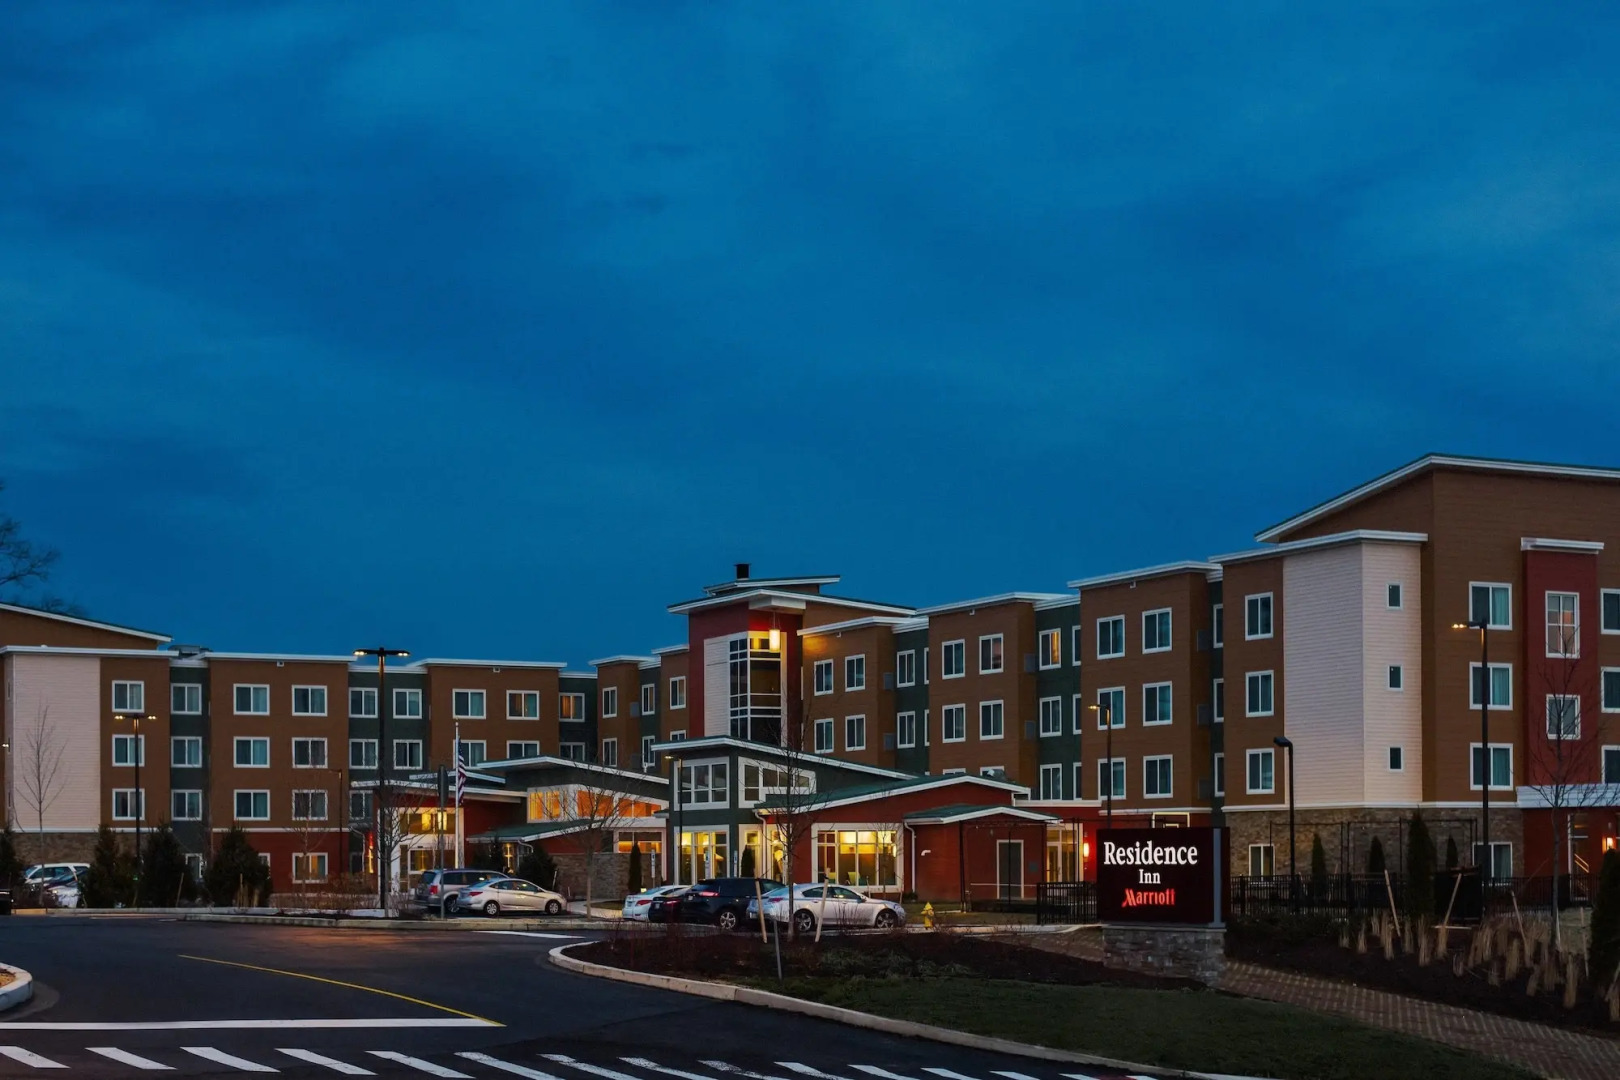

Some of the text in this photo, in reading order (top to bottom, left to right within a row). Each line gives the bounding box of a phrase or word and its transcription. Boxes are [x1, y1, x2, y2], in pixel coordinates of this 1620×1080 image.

[1103, 840, 1198, 865] Residence
[1138, 868, 1161, 884] Inn
[1121, 888, 1176, 908] Marriott
